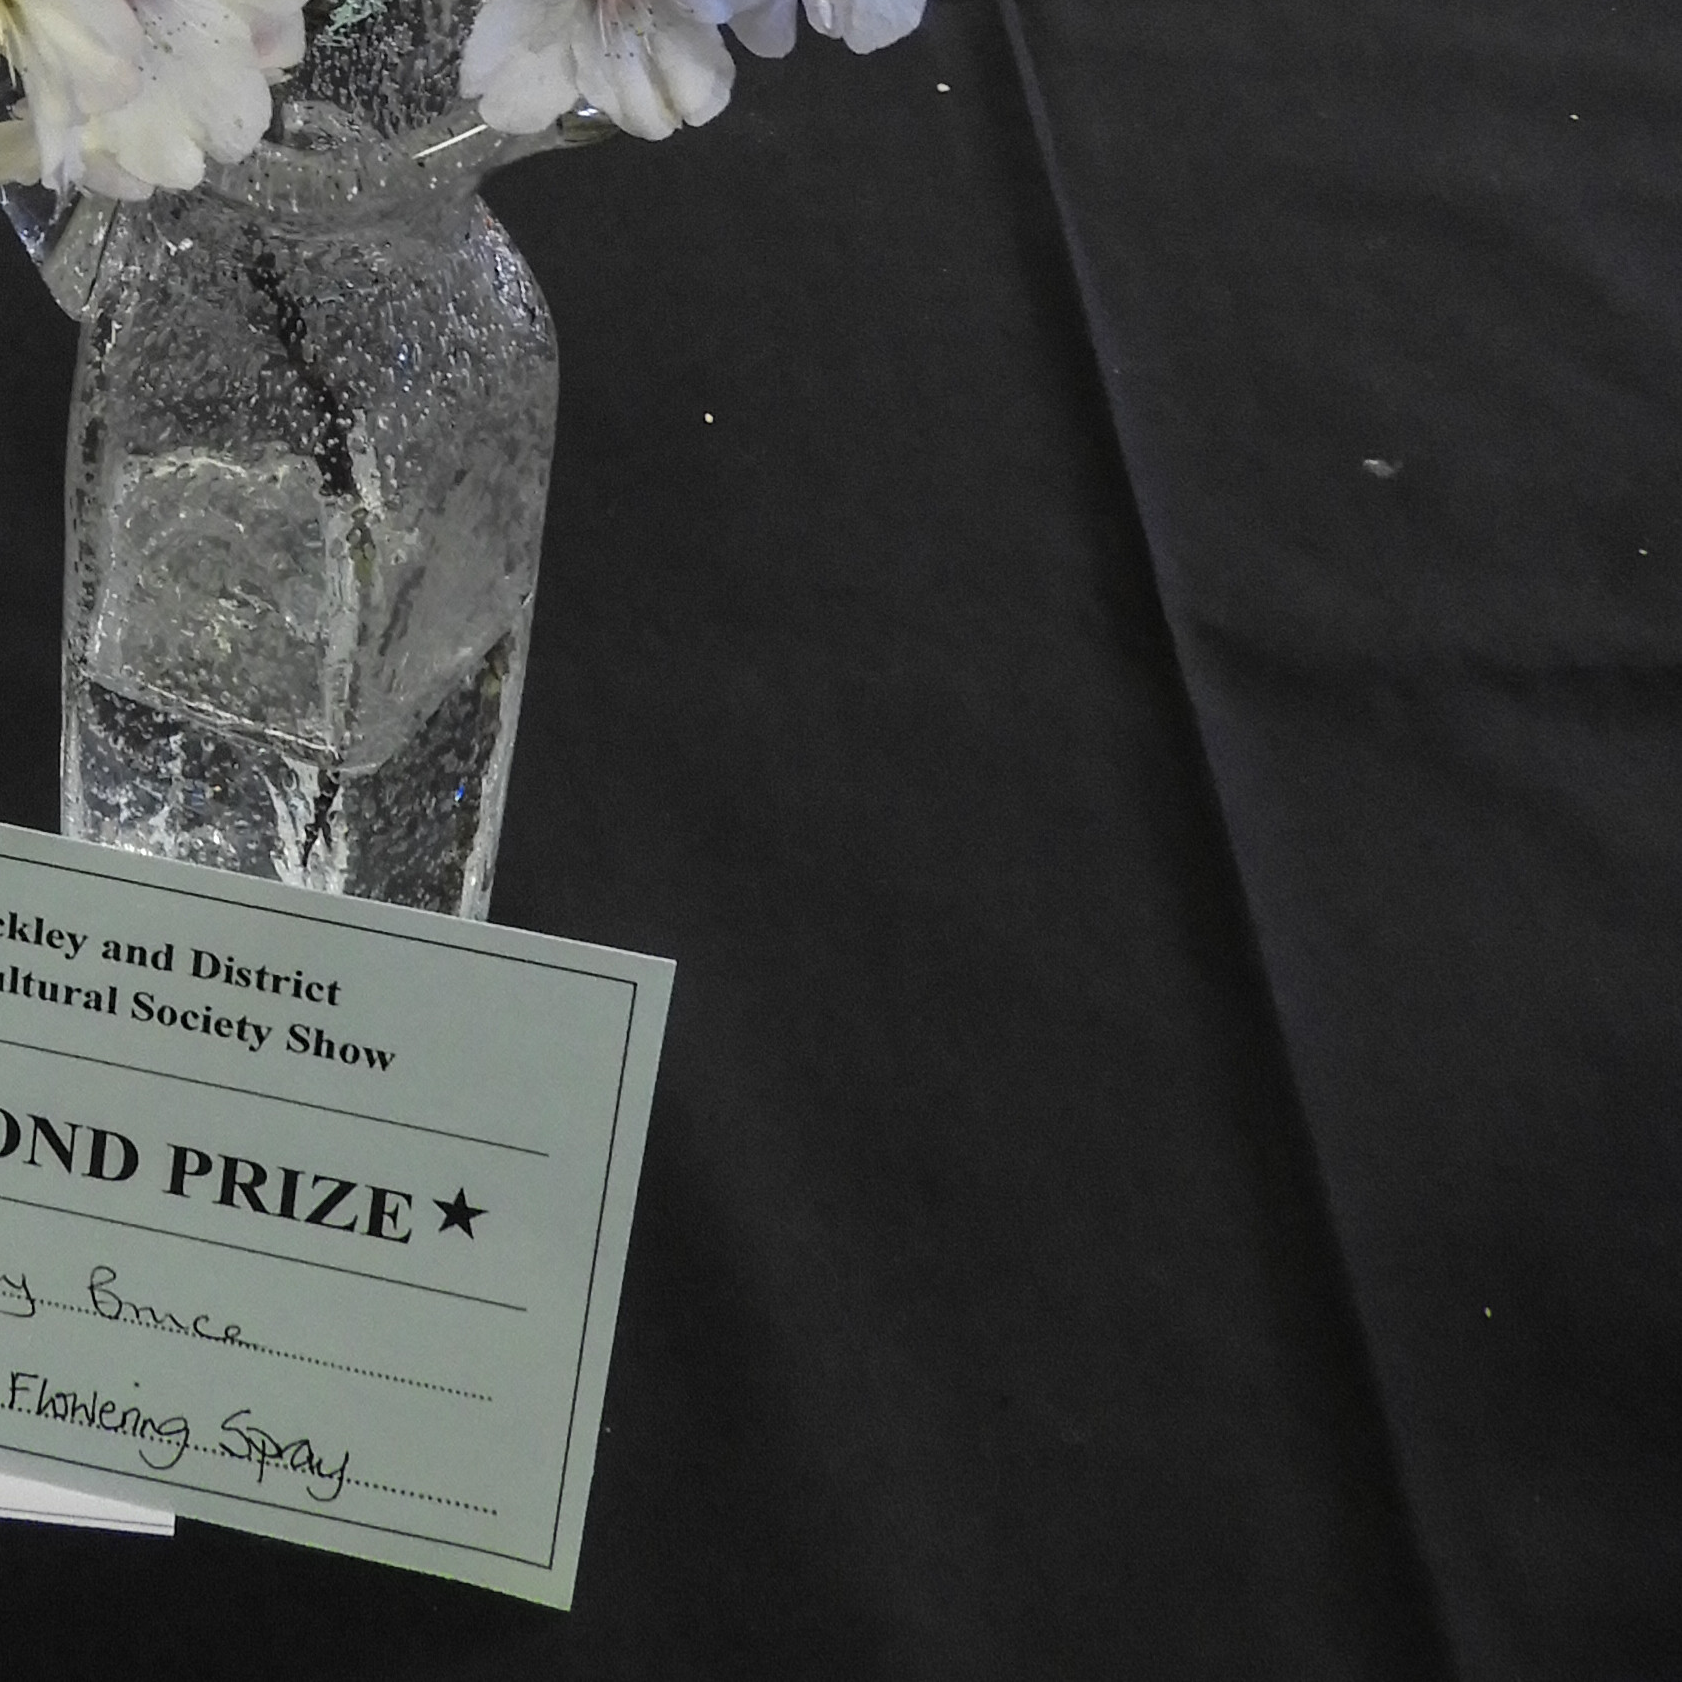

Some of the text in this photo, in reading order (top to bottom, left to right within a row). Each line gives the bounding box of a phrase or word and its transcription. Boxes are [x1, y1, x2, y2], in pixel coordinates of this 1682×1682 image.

[101, 938, 175, 973] and
[189, 947, 343, 1006] District
[130, 991, 274, 1052] Society
[285, 1022, 397, 1072] Show
[161, 1143, 414, 1246] PRIZE
[9, 1371, 350, 1502] Flowering Spray
